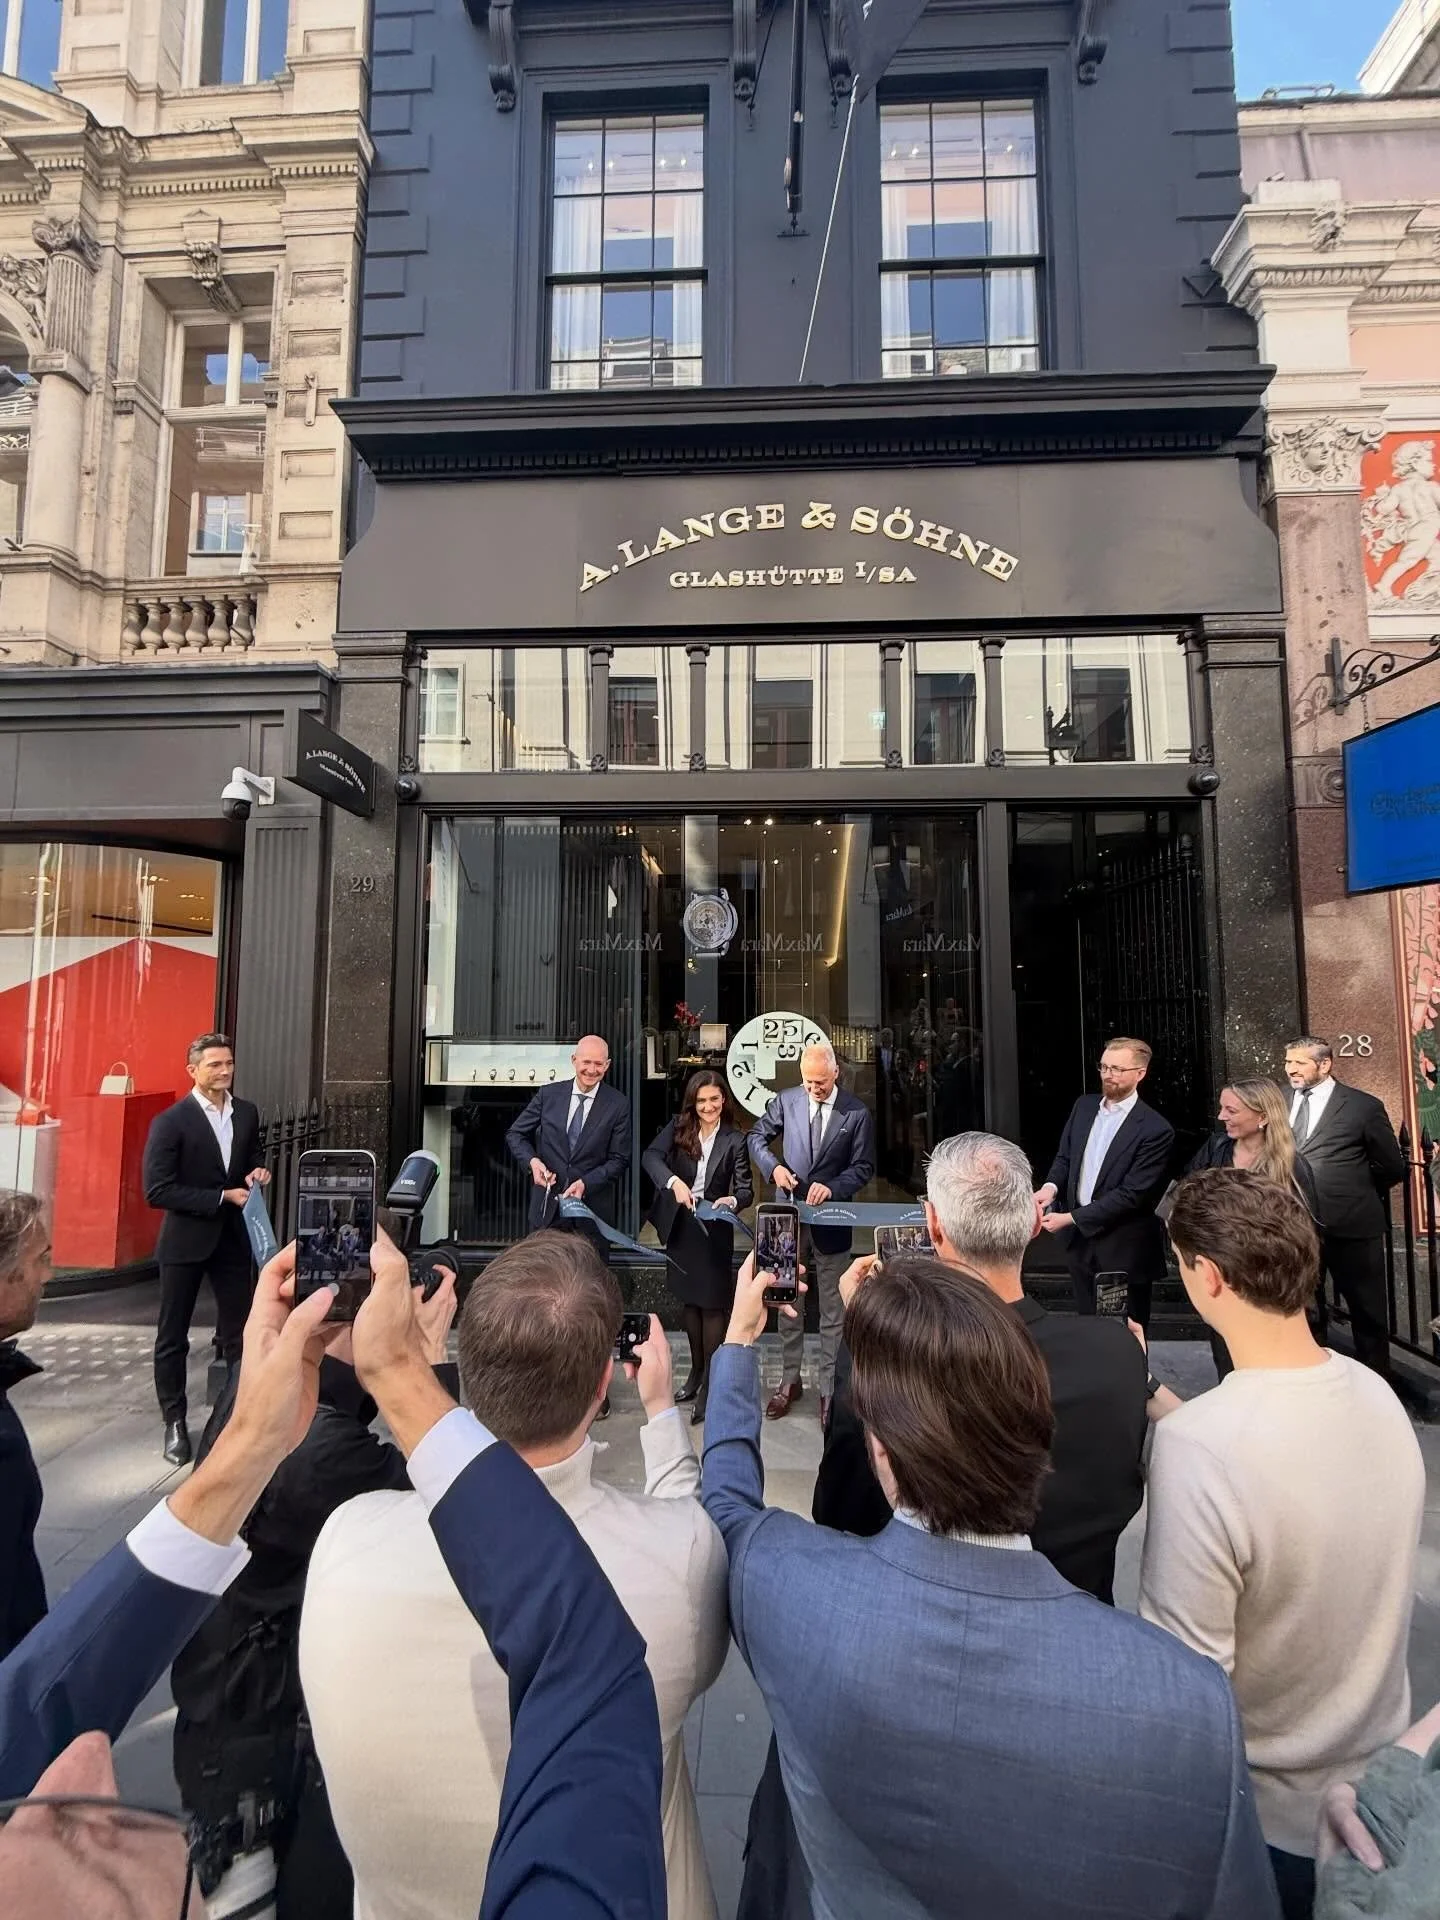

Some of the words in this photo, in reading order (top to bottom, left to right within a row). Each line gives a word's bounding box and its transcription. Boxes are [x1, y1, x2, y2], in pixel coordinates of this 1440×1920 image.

[800, 501, 836, 530] &
[850, 506, 1021, 582] SÖHNE
[669, 565, 845, 588] GLASHÜTTE
[350, 876, 375, 893] 29
[1338, 1034, 1374, 1057] 28
